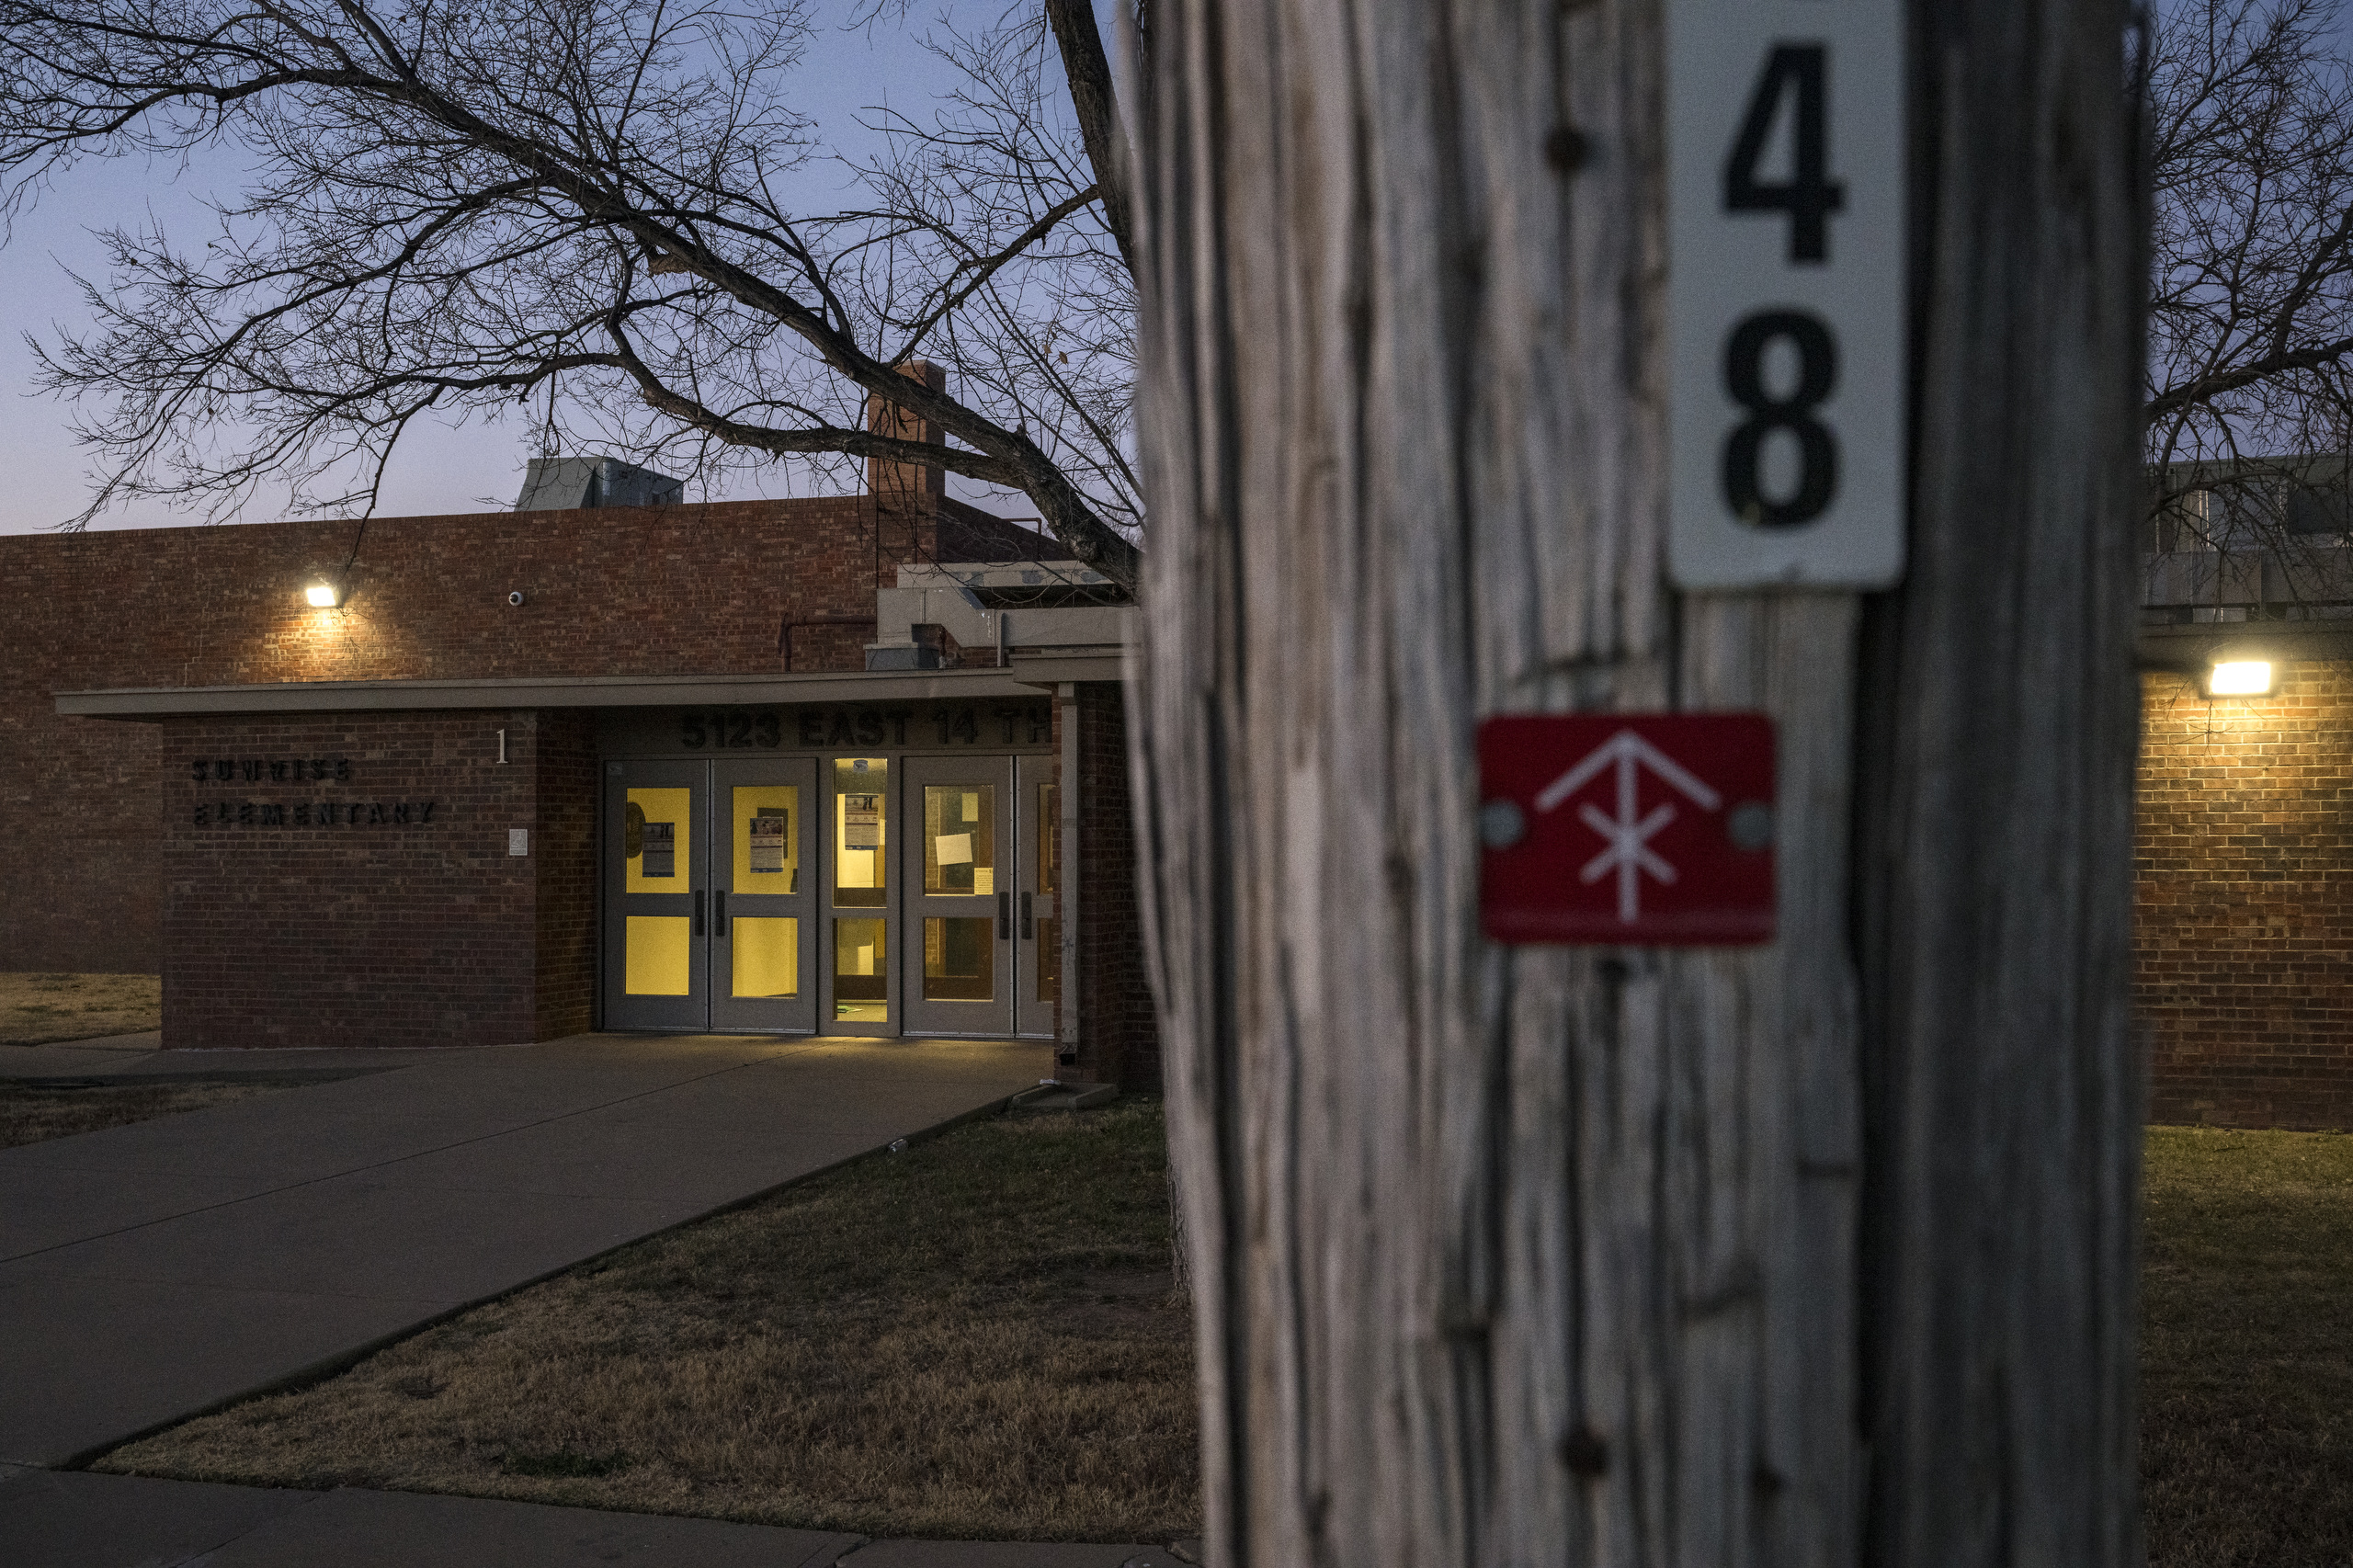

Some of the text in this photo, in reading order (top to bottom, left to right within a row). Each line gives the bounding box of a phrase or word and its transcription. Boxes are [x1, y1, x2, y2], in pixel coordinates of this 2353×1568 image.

[682, 707, 1052, 749] 5123 EAST 14 TH
[193, 802, 436, 826] ELEMENTARY
